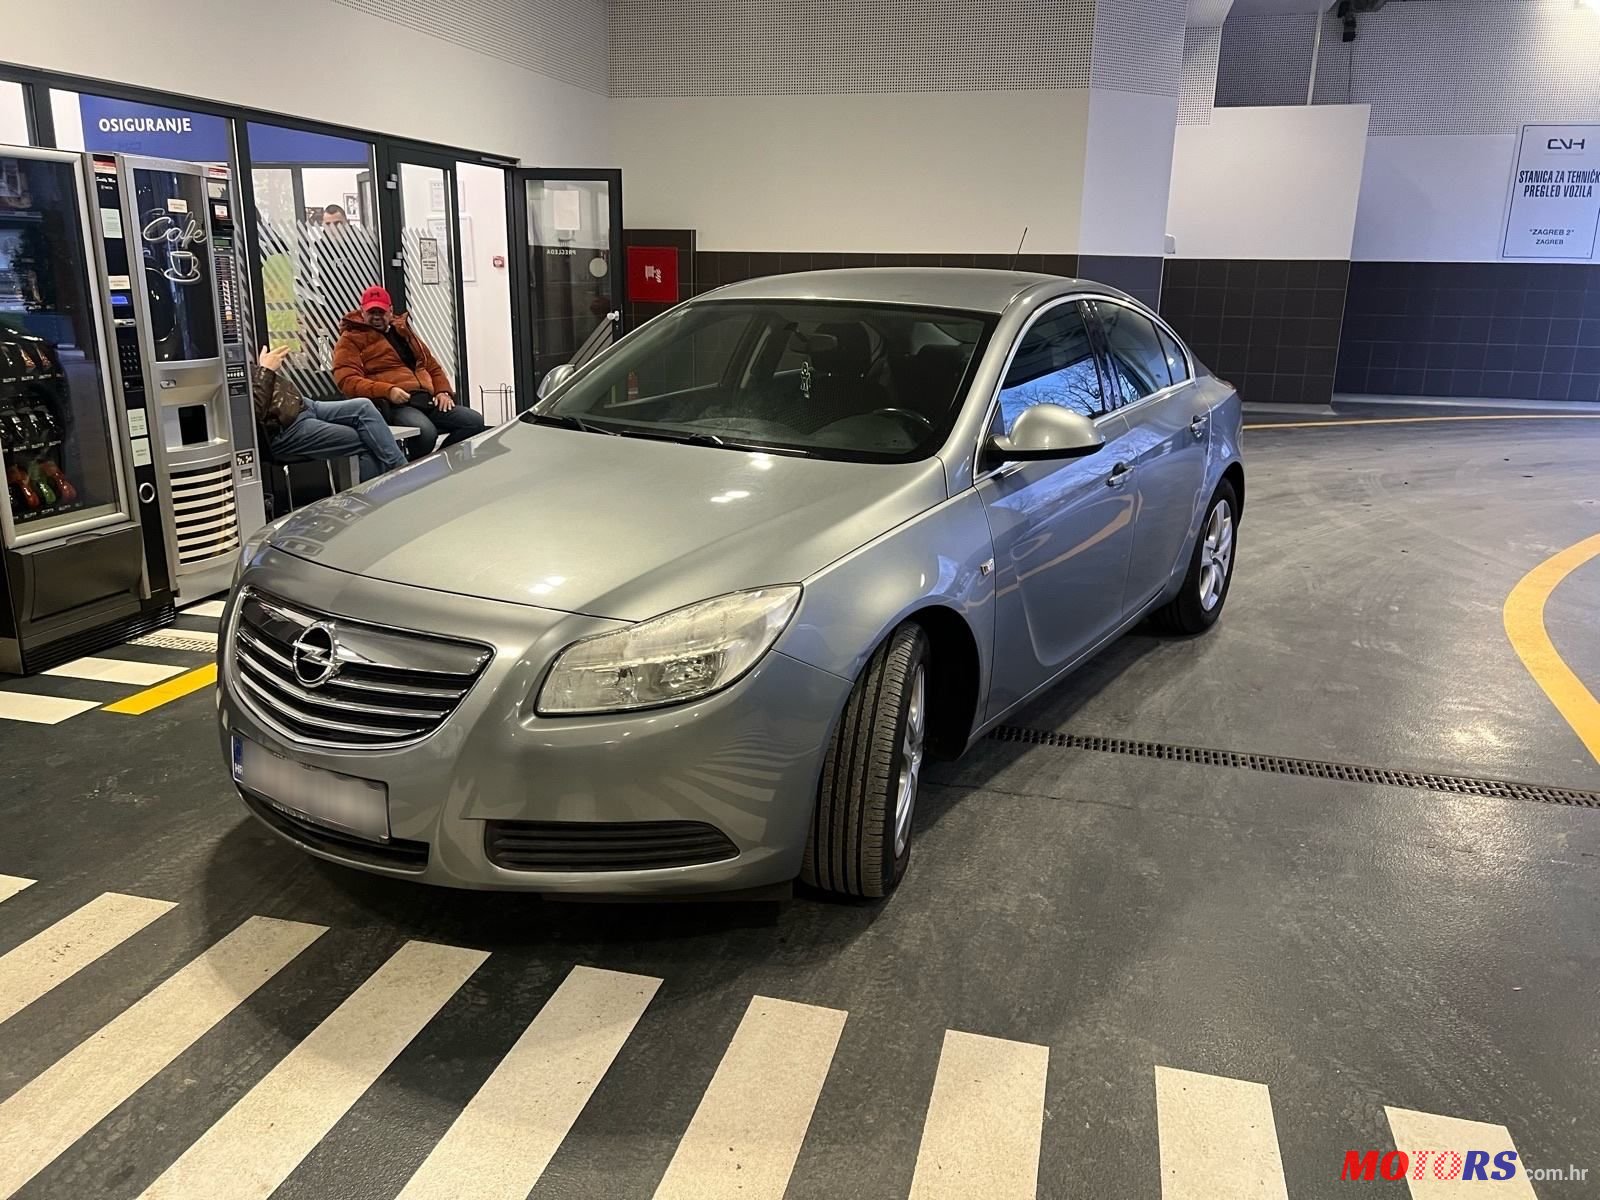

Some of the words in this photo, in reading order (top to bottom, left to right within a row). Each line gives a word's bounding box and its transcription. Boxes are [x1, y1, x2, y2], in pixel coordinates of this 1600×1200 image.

[98, 118, 193, 134] OSIGURANJE
[1547, 138, 1586, 150] CVH
[1519, 170, 1553, 184] STANICA
[1554, 170, 1565, 184] ZA
[1524, 185, 1561, 197] PREGLED
[1564, 185, 1592, 198] VOZILA
